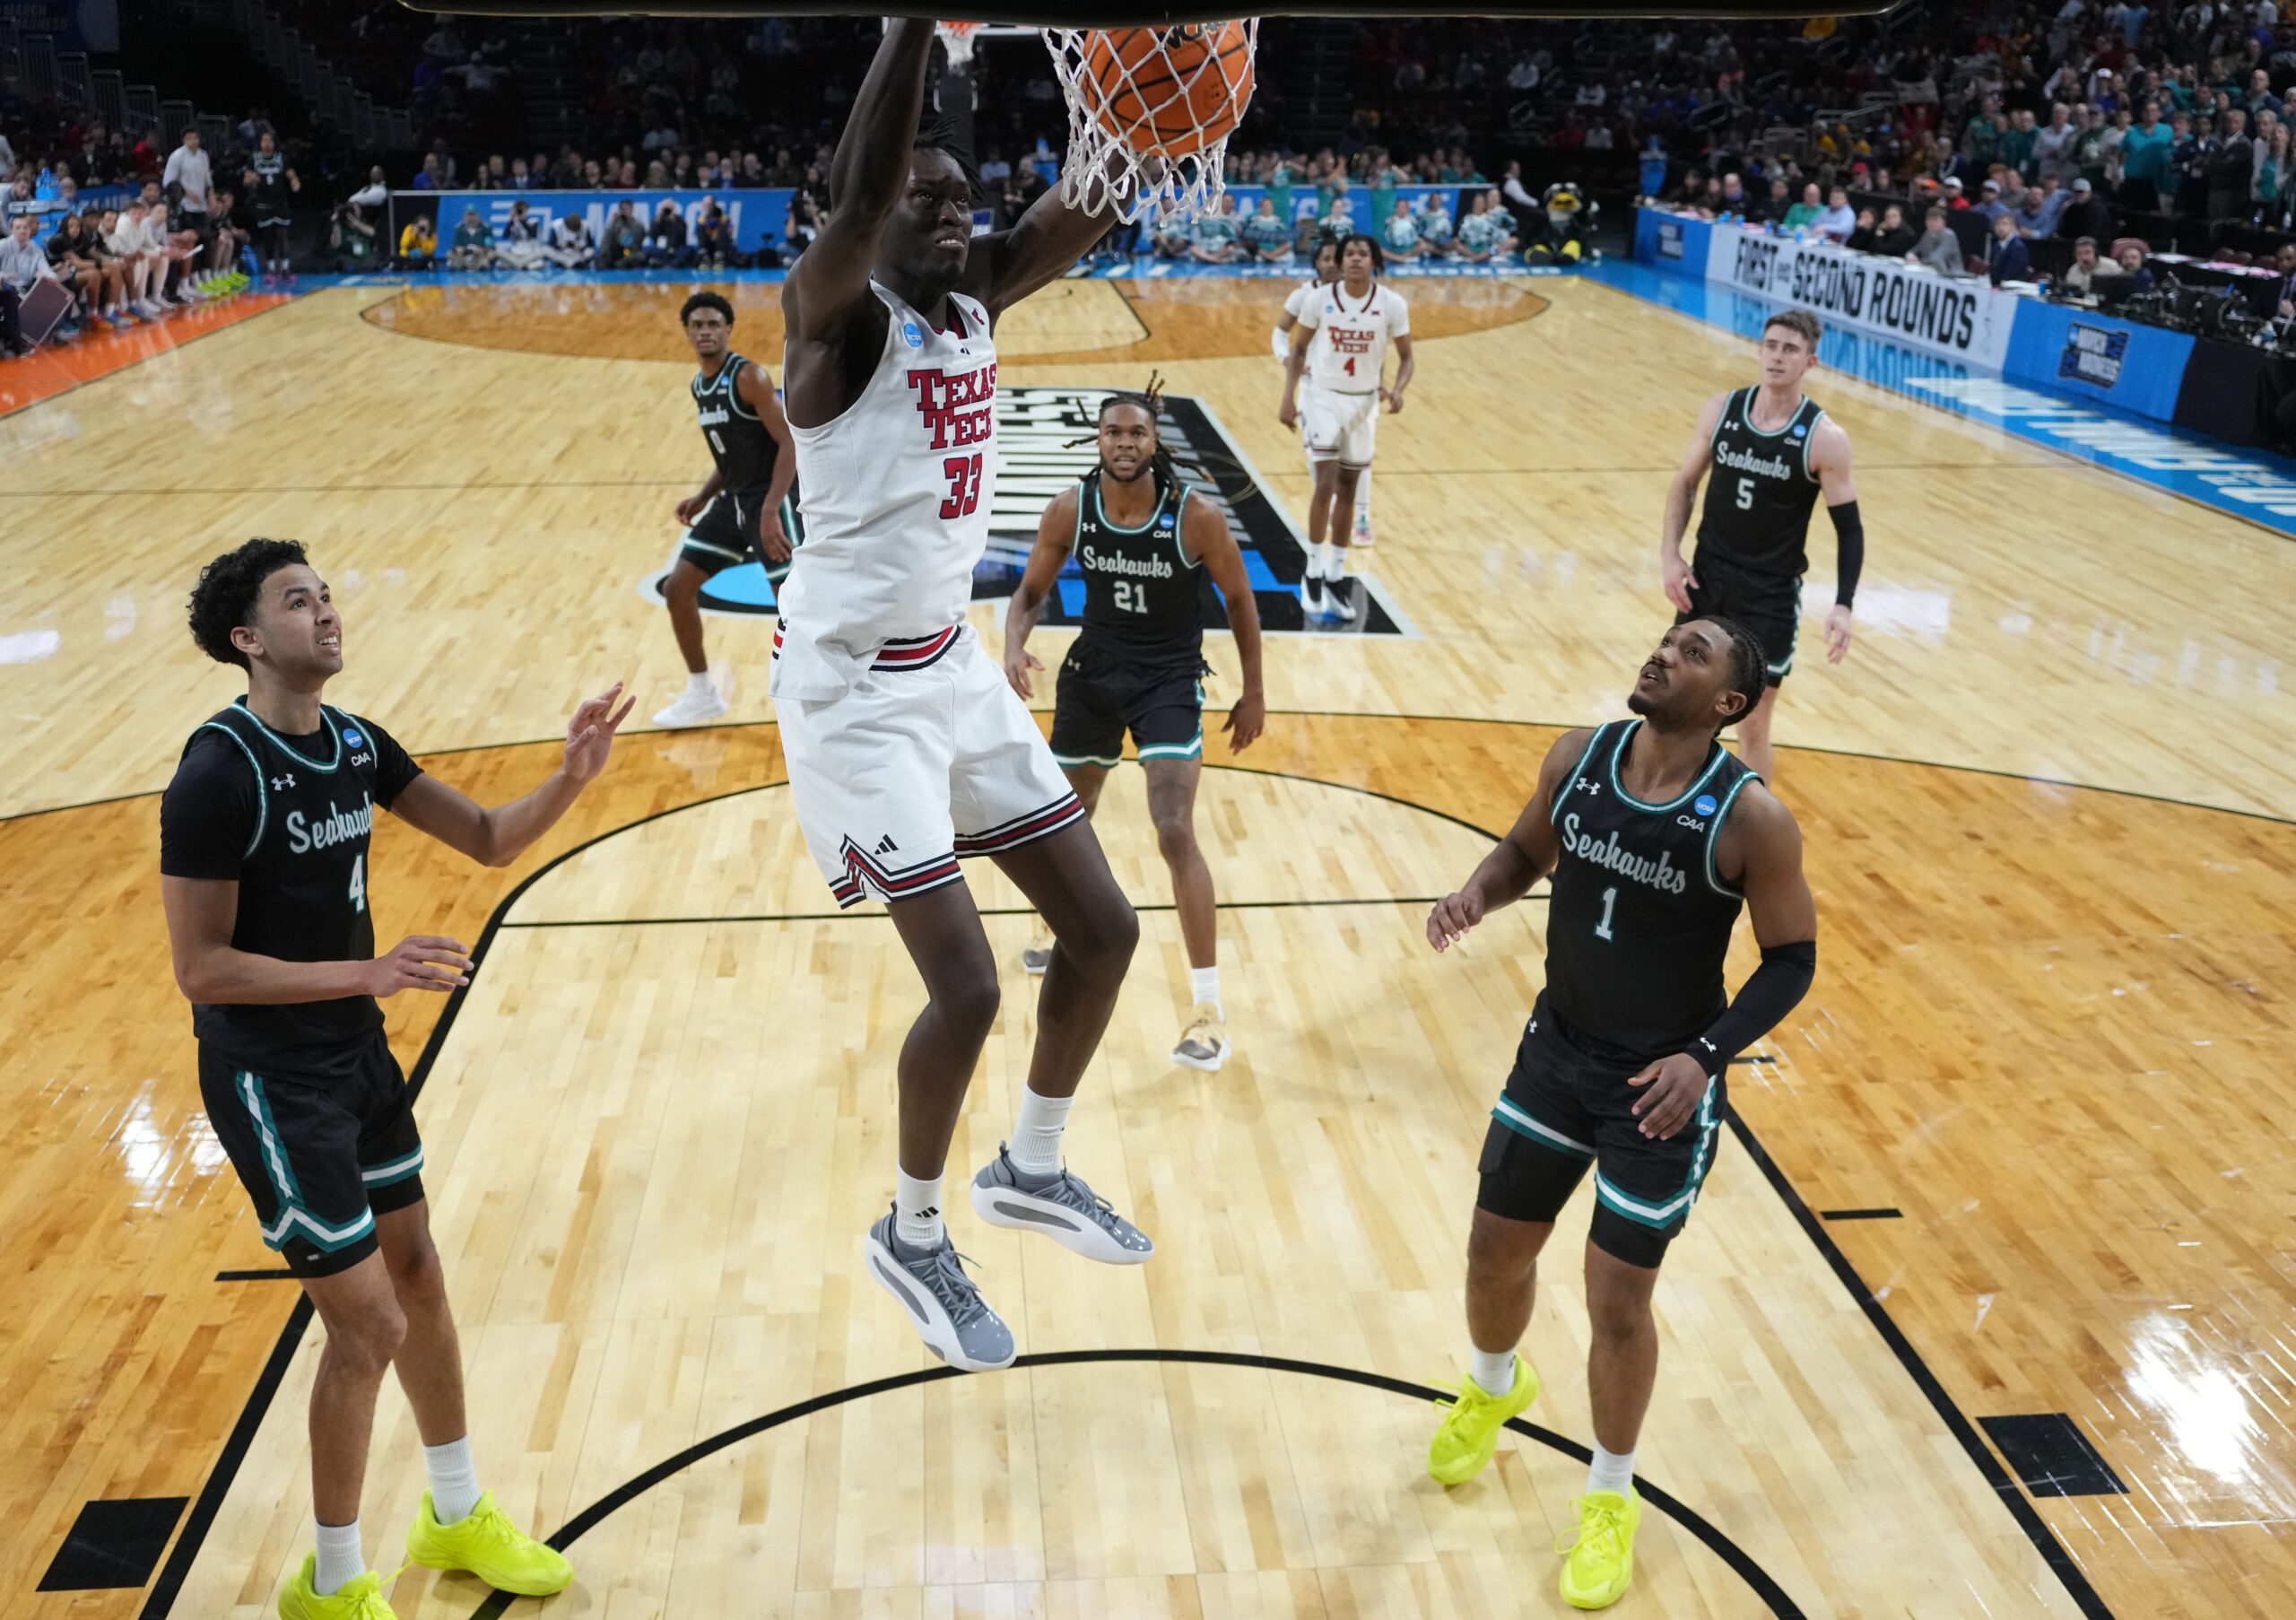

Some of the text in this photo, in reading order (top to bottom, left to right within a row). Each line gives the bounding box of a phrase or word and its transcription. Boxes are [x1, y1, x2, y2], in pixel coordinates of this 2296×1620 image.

[1733, 235, 1779, 292] FIRST
[1790, 250, 1866, 318] SECOND
[1867, 270, 1976, 351] ROUNDS
[1328, 326, 1375, 342] TEXAS
[1344, 356, 1355, 377] 4
[1717, 440, 1791, 481] Seahawks
[938, 452, 982, 519] 33
[1735, 478, 1755, 510] 5
[1083, 545, 1173, 579] Seahawks
[1114, 580, 1148, 614] 21
[351, 752, 372, 767] CAA
[286, 790, 374, 853] Seahawk
[1676, 814, 1705, 833] CAA
[1561, 813, 1686, 894] Seahawks
[349, 852, 364, 914] 4
[1593, 884, 1618, 942] 1
